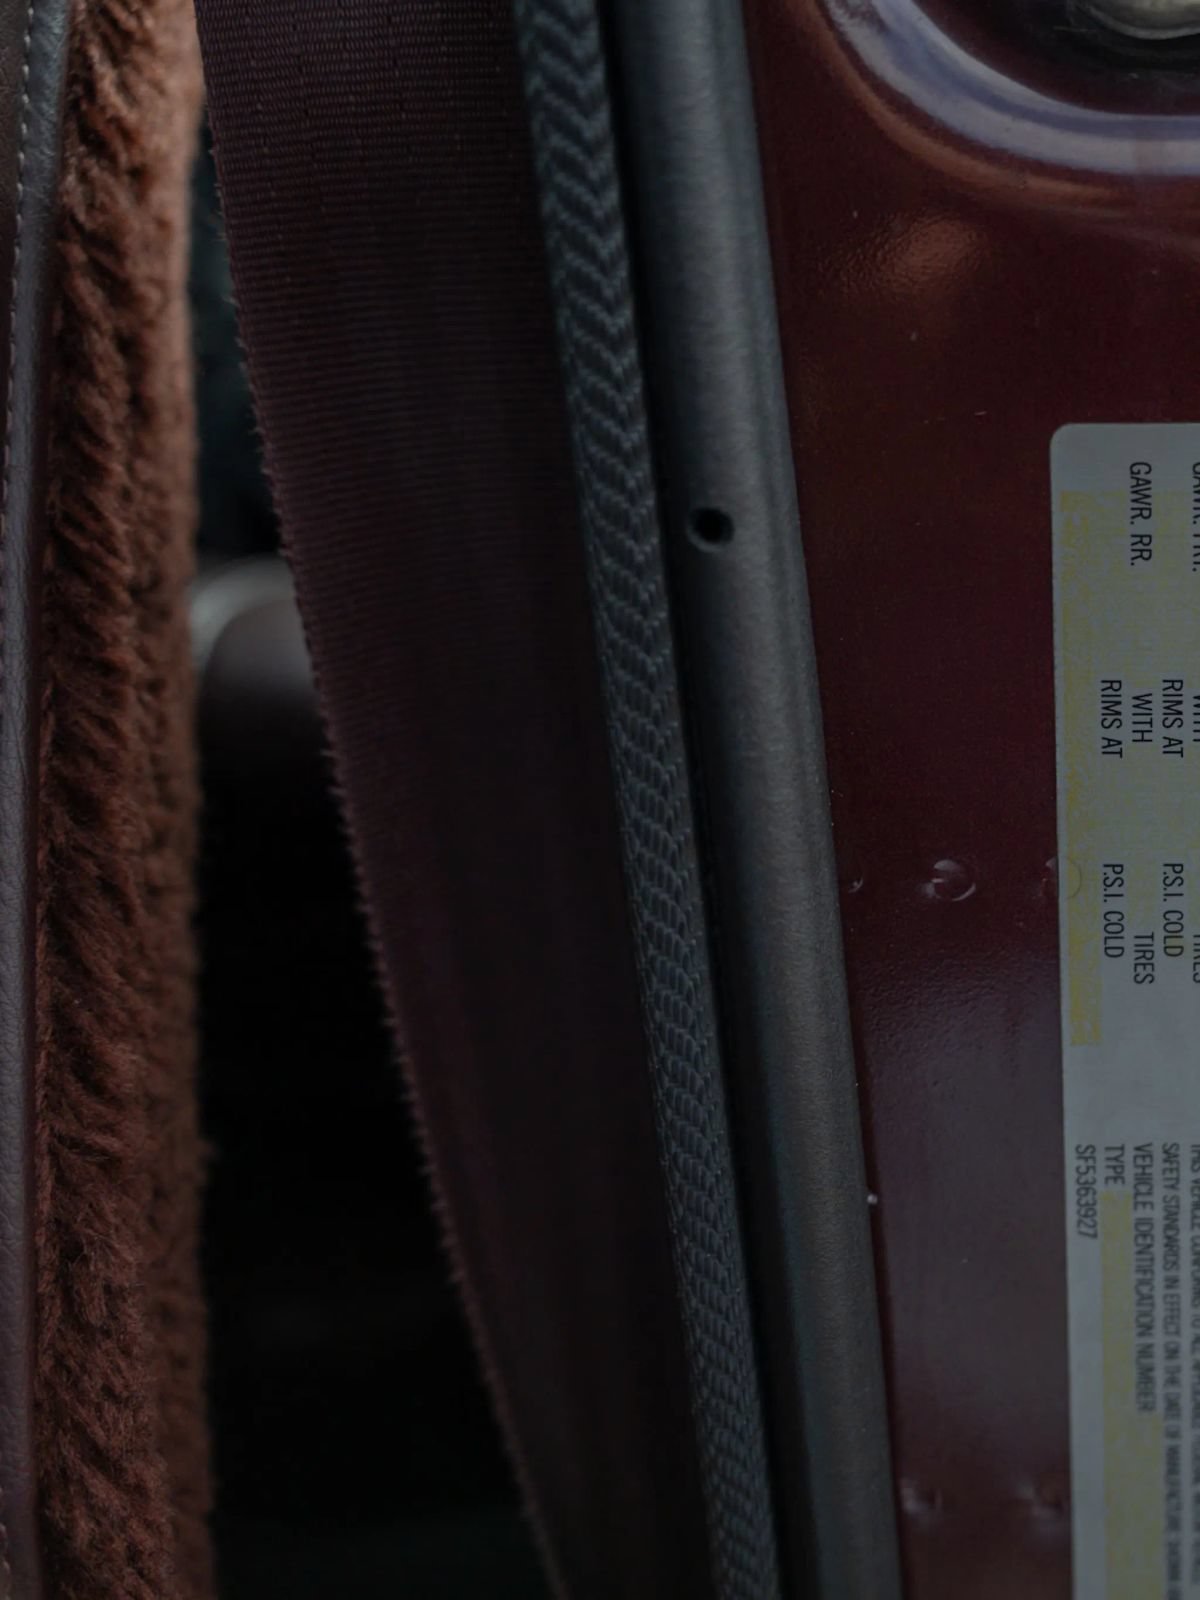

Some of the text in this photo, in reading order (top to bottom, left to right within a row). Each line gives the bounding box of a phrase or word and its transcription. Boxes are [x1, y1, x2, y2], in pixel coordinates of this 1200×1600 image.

[1129, 461, 1153, 566] GAWR. RR.
[1100, 679, 1123, 759] RIMS AT
[1131, 692, 1153, 743] WITH
[1161, 679, 1184, 758] RIMS AT
[1102, 863, 1125, 959] P.S.I. COLD
[1162, 863, 1185, 958] P.S.I. COLD
[1133, 932, 1155, 985] TIRES
[1074, 1143, 1099, 1240] SF5363927
[1104, 1143, 1126, 1185] TYPE
[1161, 1142, 1181, 1191] SAFETY
[1162, 1194, 1181, 1272] STANDARDS
[1132, 1142, 1156, 1412] VEHICLE IDENTIFICATION NUMBER
[1162, 1293, 1182, 1337] EFFECT
[1163, 1275, 1180, 1290] IN
